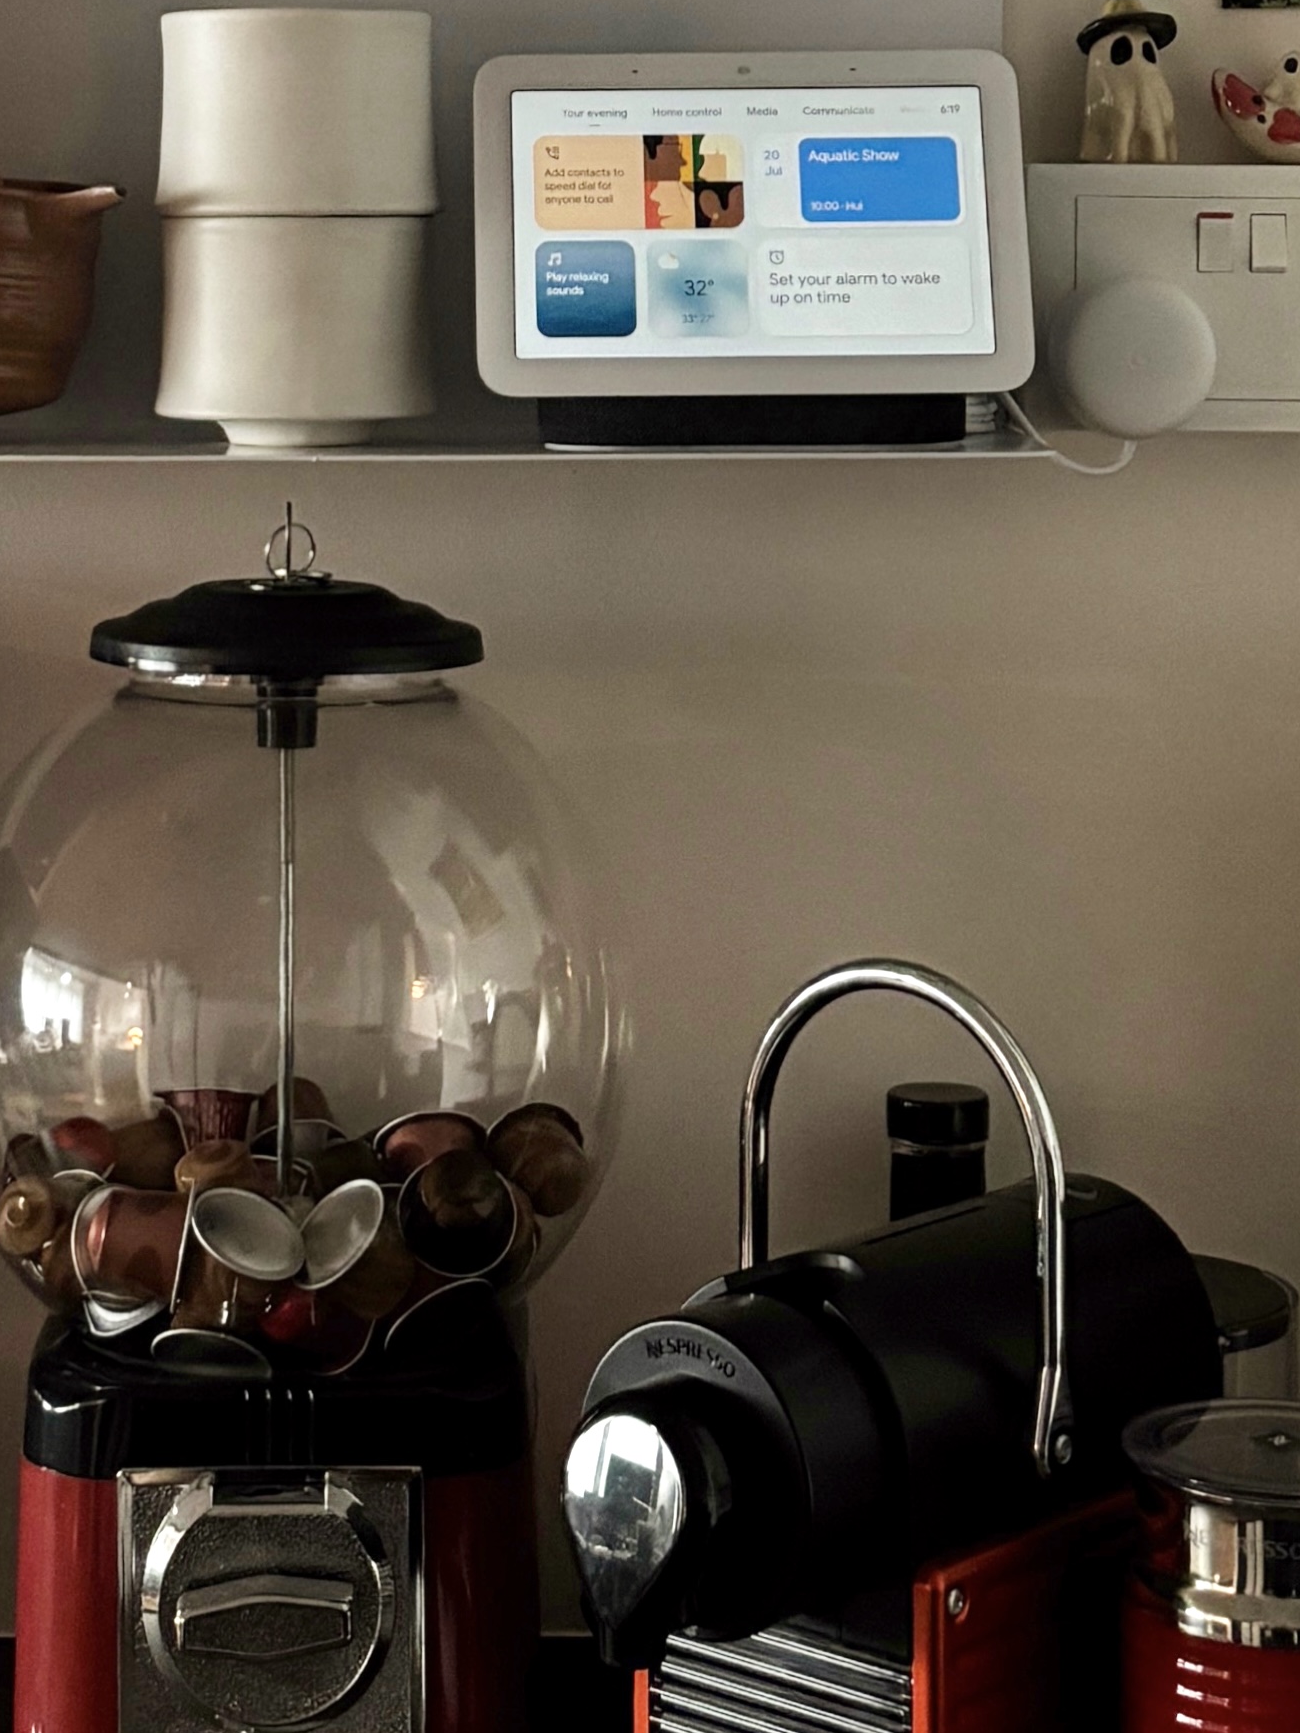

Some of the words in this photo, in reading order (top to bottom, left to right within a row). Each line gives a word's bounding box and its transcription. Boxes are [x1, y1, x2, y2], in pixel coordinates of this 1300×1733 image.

[563, 108, 584, 118] Your
[587, 109, 628, 120] evening
[652, 107, 683, 117] Home
[685, 107, 723, 117] control
[747, 106, 778, 116] Media
[802, 105, 875, 116] Communicate
[940, 104, 960, 115] 6:19
[764, 150, 780, 161] 20
[808, 149, 859, 163] Aquatic
[862, 148, 899, 162] Show
[544, 168, 565, 178] Add
[567, 168, 611, 178] contacts
[613, 168, 625, 178] to
[765, 165, 783, 176] Jul
[544, 181, 576, 192] speed
[578, 181, 596, 191] dial
[545, 196, 582, 206] anyone
[584, 194, 595, 204] to
[597, 194, 614, 204] call
[546, 271, 567, 283] Play
[569, 271, 610, 283] relaxing
[769, 272, 794, 286] Set
[798, 275, 831, 289] your
[835, 272, 878, 285] alarm
[882, 273, 898, 285] to
[901, 271, 941, 285] wake
[546, 285, 584, 296] sounds
[684, 279, 715, 297] 32°
[770, 293, 790, 306] up
[793, 293, 813, 304] on
[817, 291, 851, 304] time
